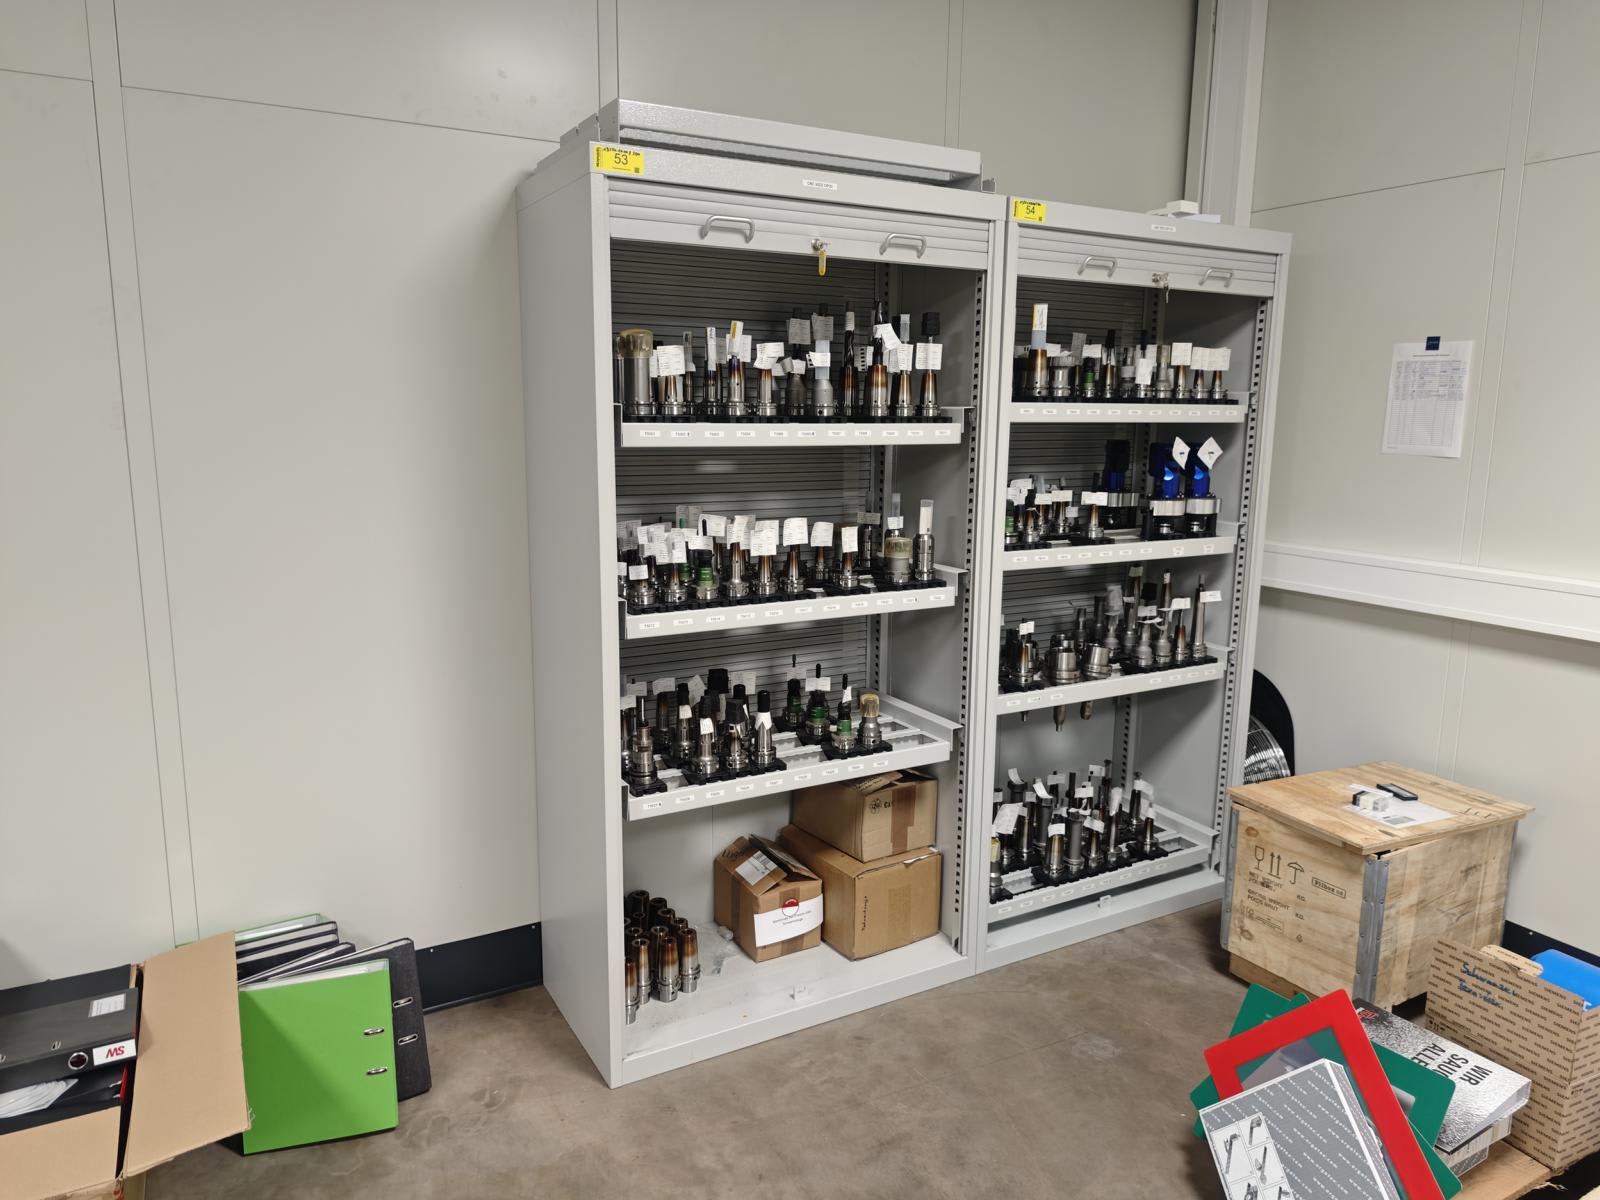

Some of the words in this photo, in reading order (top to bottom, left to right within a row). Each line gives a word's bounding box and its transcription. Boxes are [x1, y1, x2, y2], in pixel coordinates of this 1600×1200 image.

[614, 153, 628, 165] 53
[1025, 205, 1035, 215] 54
[1459, 1065, 1493, 1086] WIR
